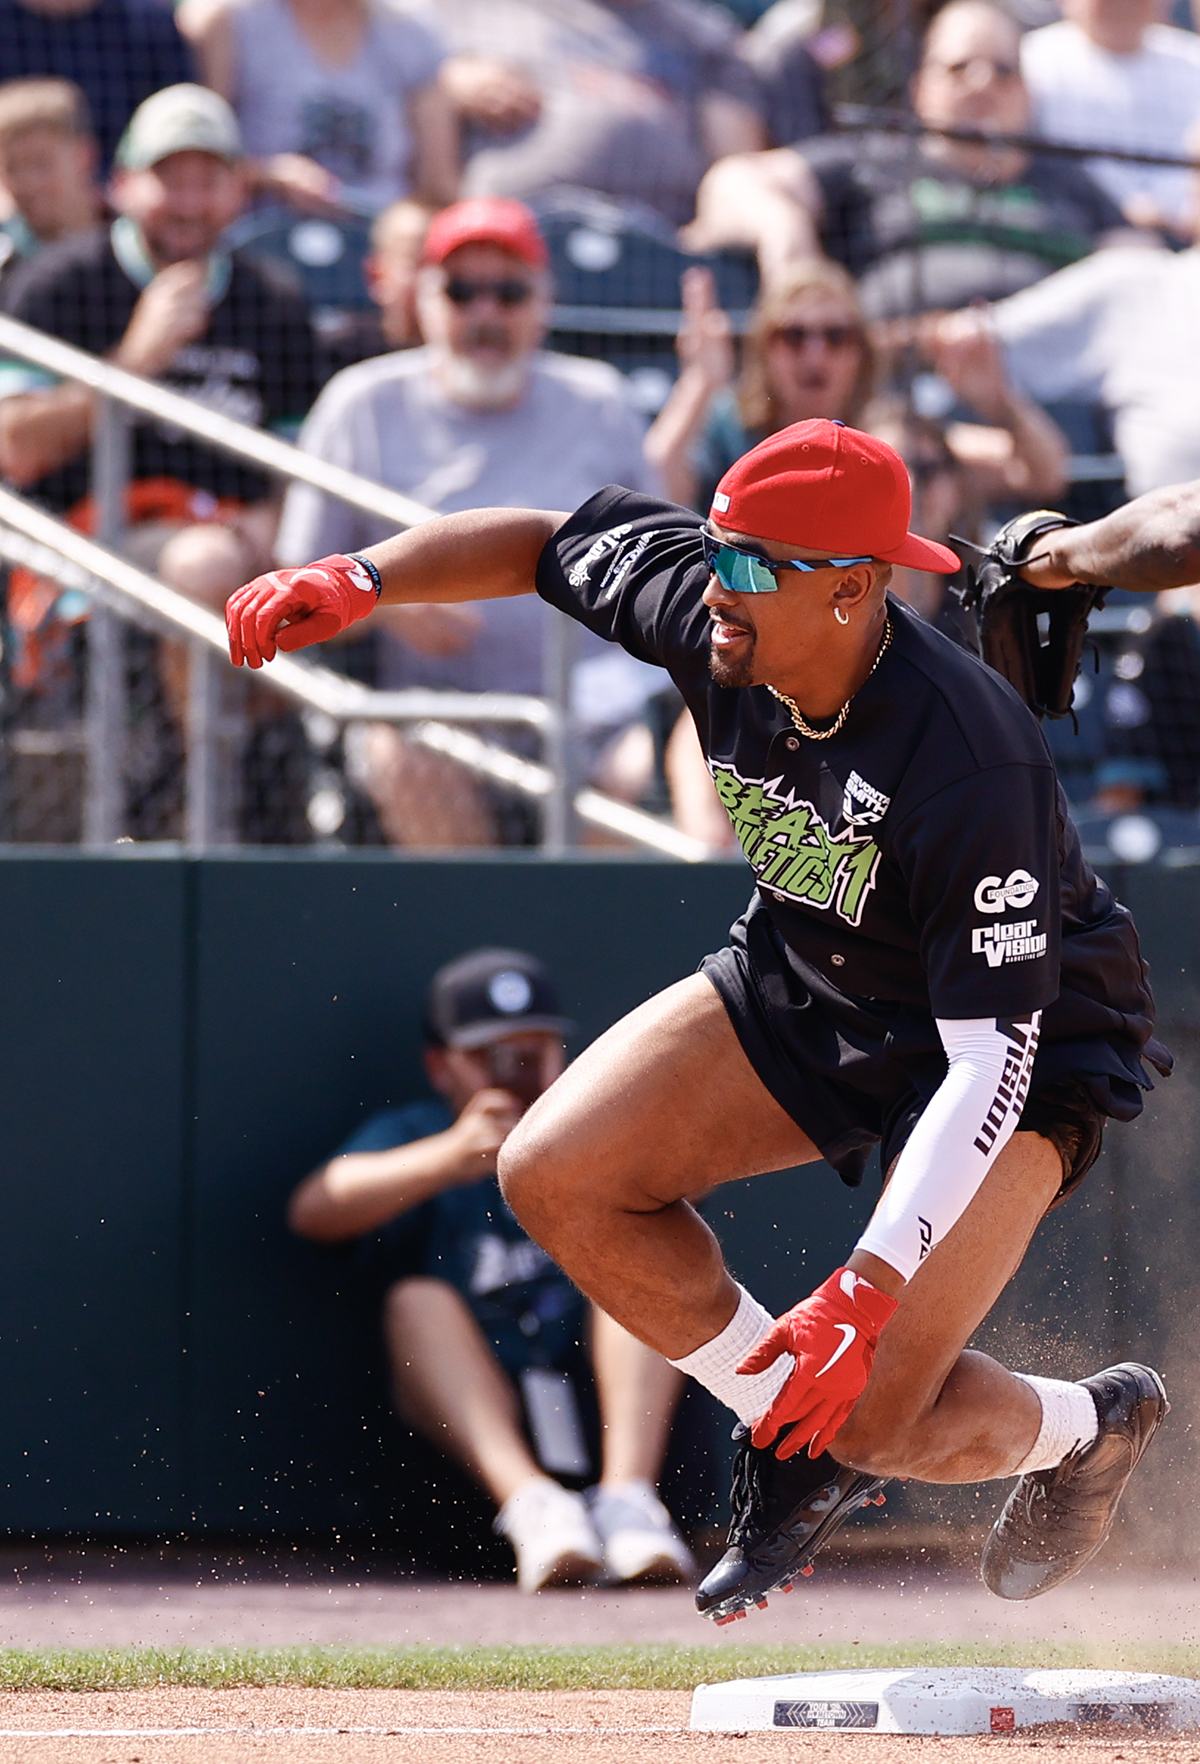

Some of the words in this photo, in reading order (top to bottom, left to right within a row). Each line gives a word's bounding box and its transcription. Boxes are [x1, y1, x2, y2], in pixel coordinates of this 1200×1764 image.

[845, 778, 888, 816] SMITH
[850, 770, 891, 807] DEVONTA
[713, 768, 861, 874] BEAST
[728, 814, 832, 903] HLETICS
[973, 869, 1036, 914] GO
[989, 882, 1035, 899] FOUNDATION
[810, 1702, 829, 1711] YOUR
[817, 1719, 836, 1727] TEAM
